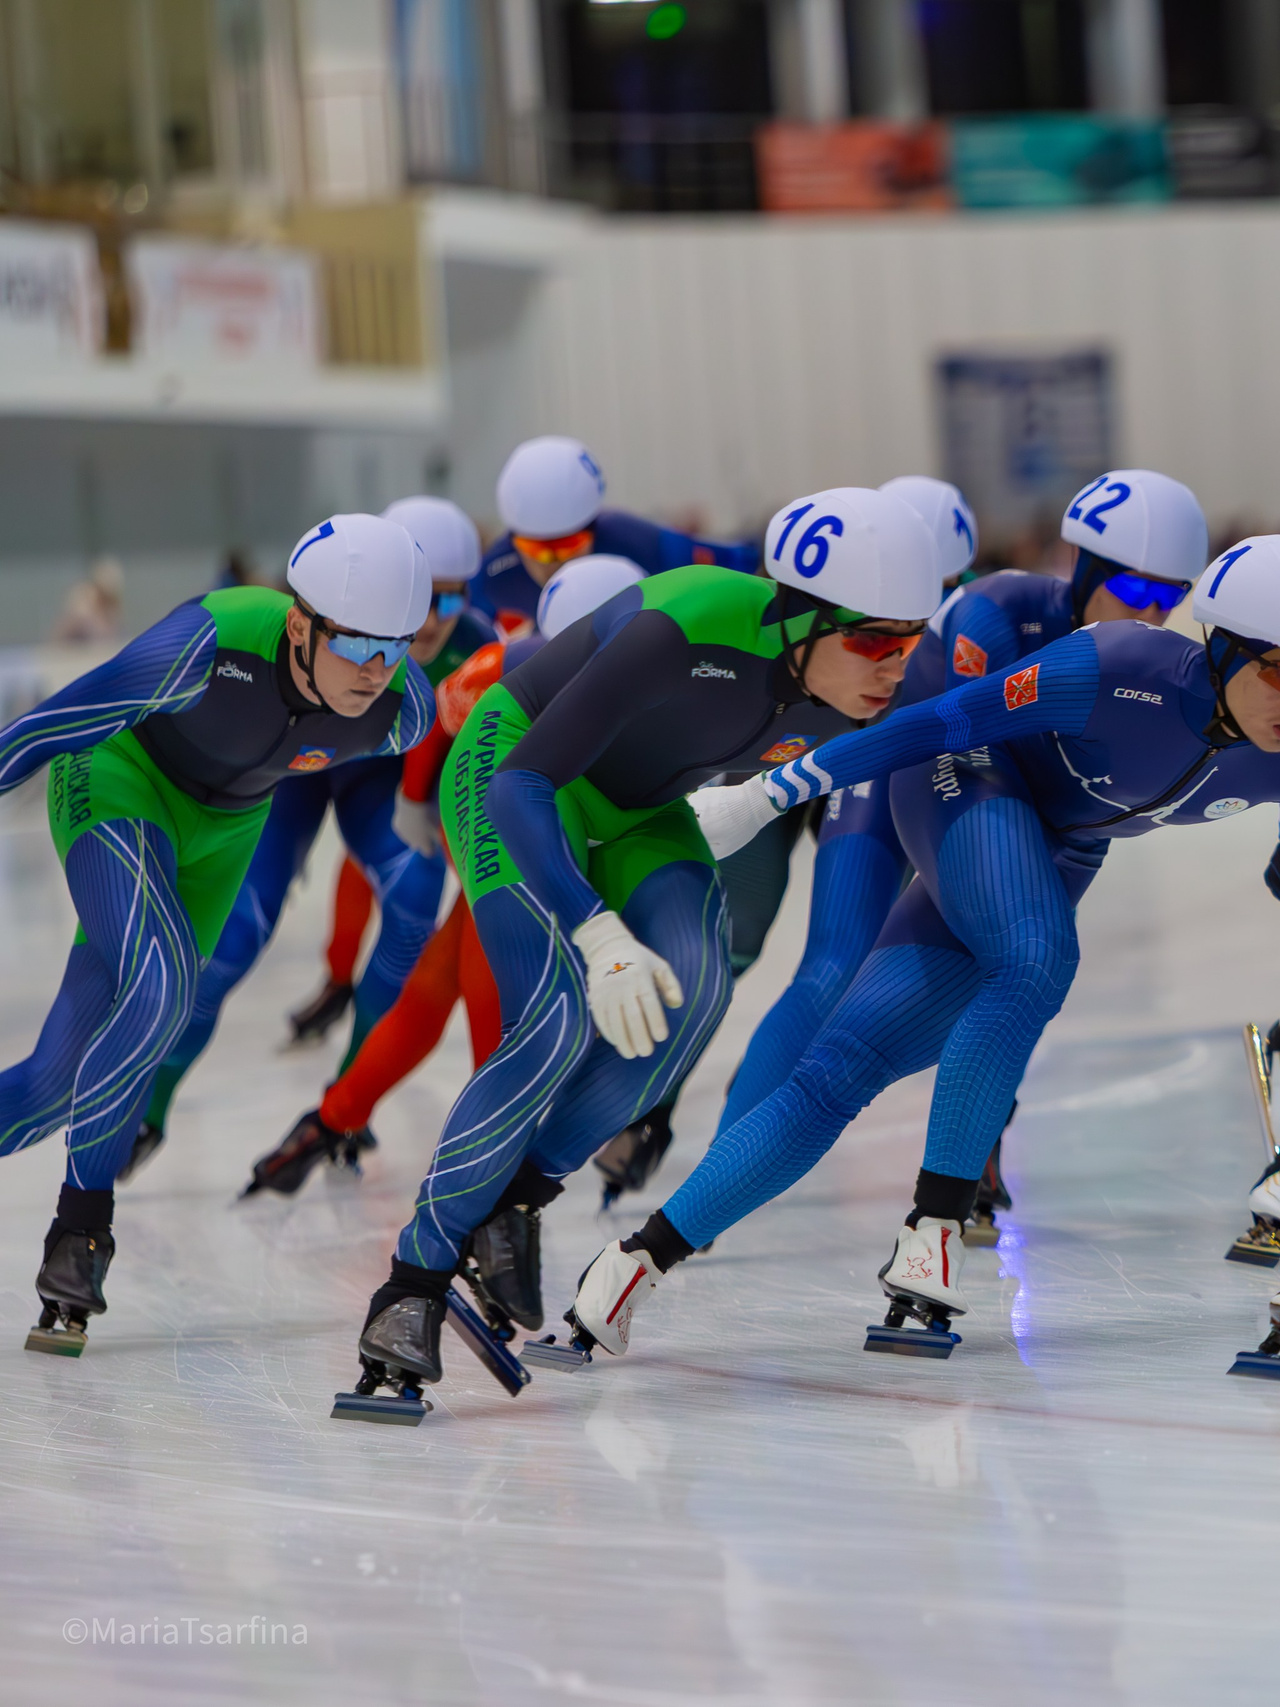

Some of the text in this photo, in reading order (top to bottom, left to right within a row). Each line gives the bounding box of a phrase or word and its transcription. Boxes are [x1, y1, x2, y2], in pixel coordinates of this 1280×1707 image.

[1067, 475, 1132, 536] 22
[772, 502, 844, 579] 16
[1206, 544, 1254, 600] 1
[217, 665, 254, 684] FORMA
[690, 667, 737, 681] FORMA
[1113, 687, 1164, 706] corsa
